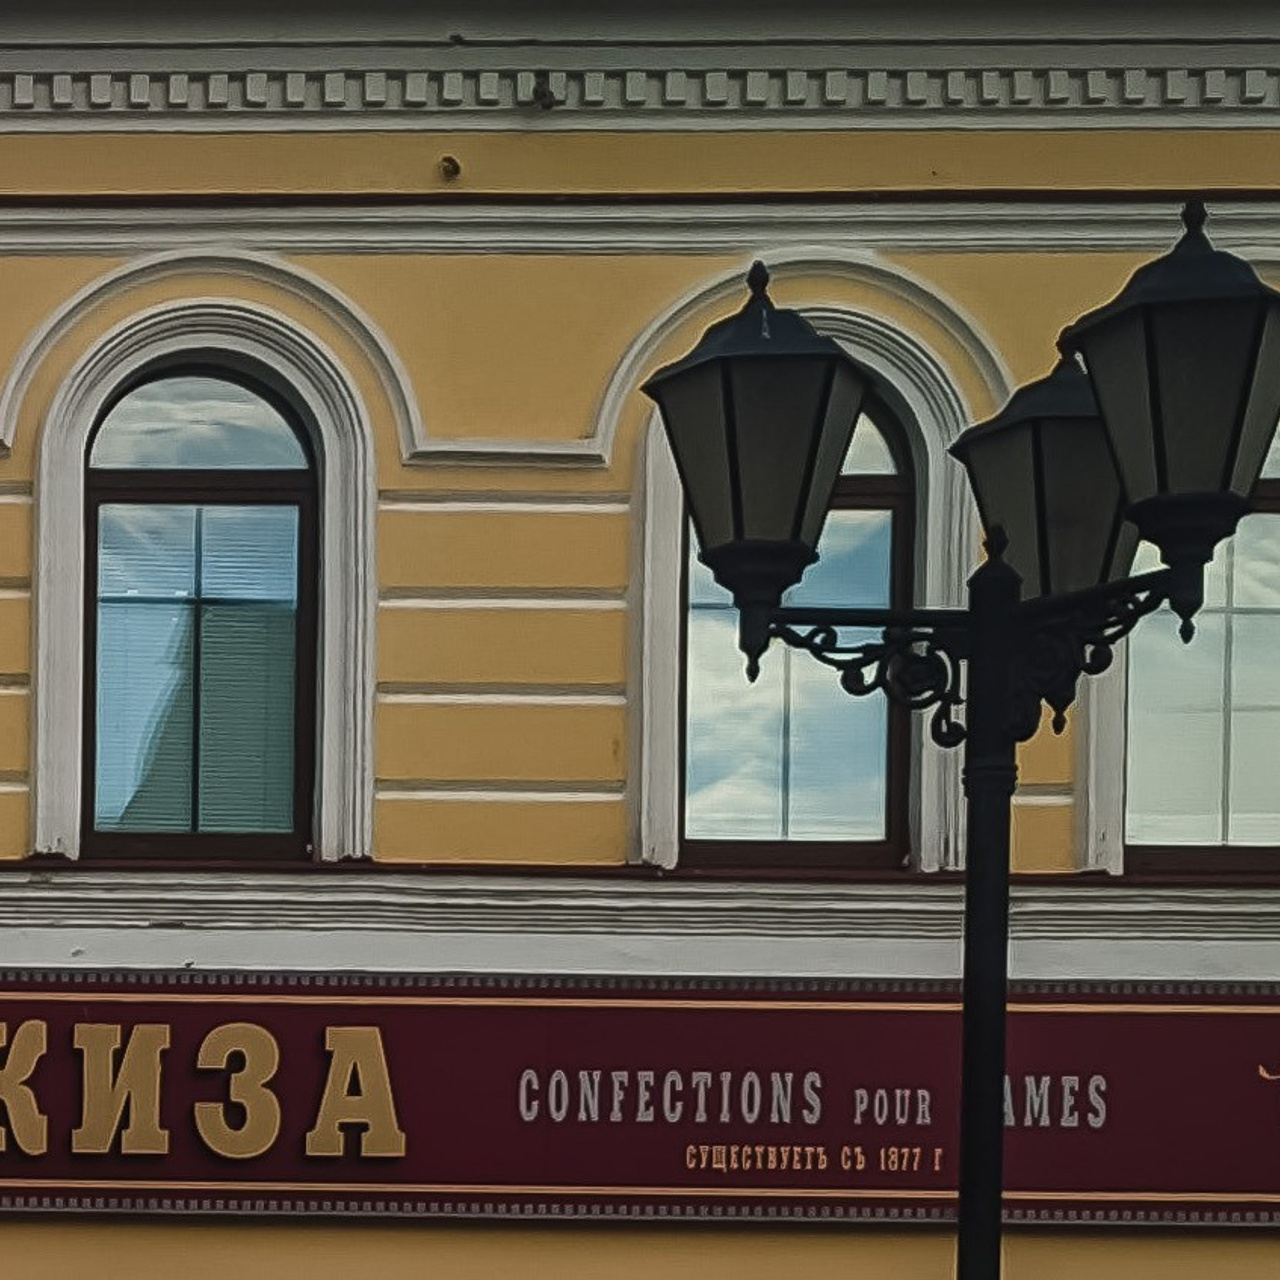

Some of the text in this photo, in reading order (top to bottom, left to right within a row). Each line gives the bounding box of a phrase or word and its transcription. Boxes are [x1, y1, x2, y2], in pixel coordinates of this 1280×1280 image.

[519, 1069, 1107, 1128] CONFECTIONS POUR AMES
[880, 1147, 922, 1171] 1877
